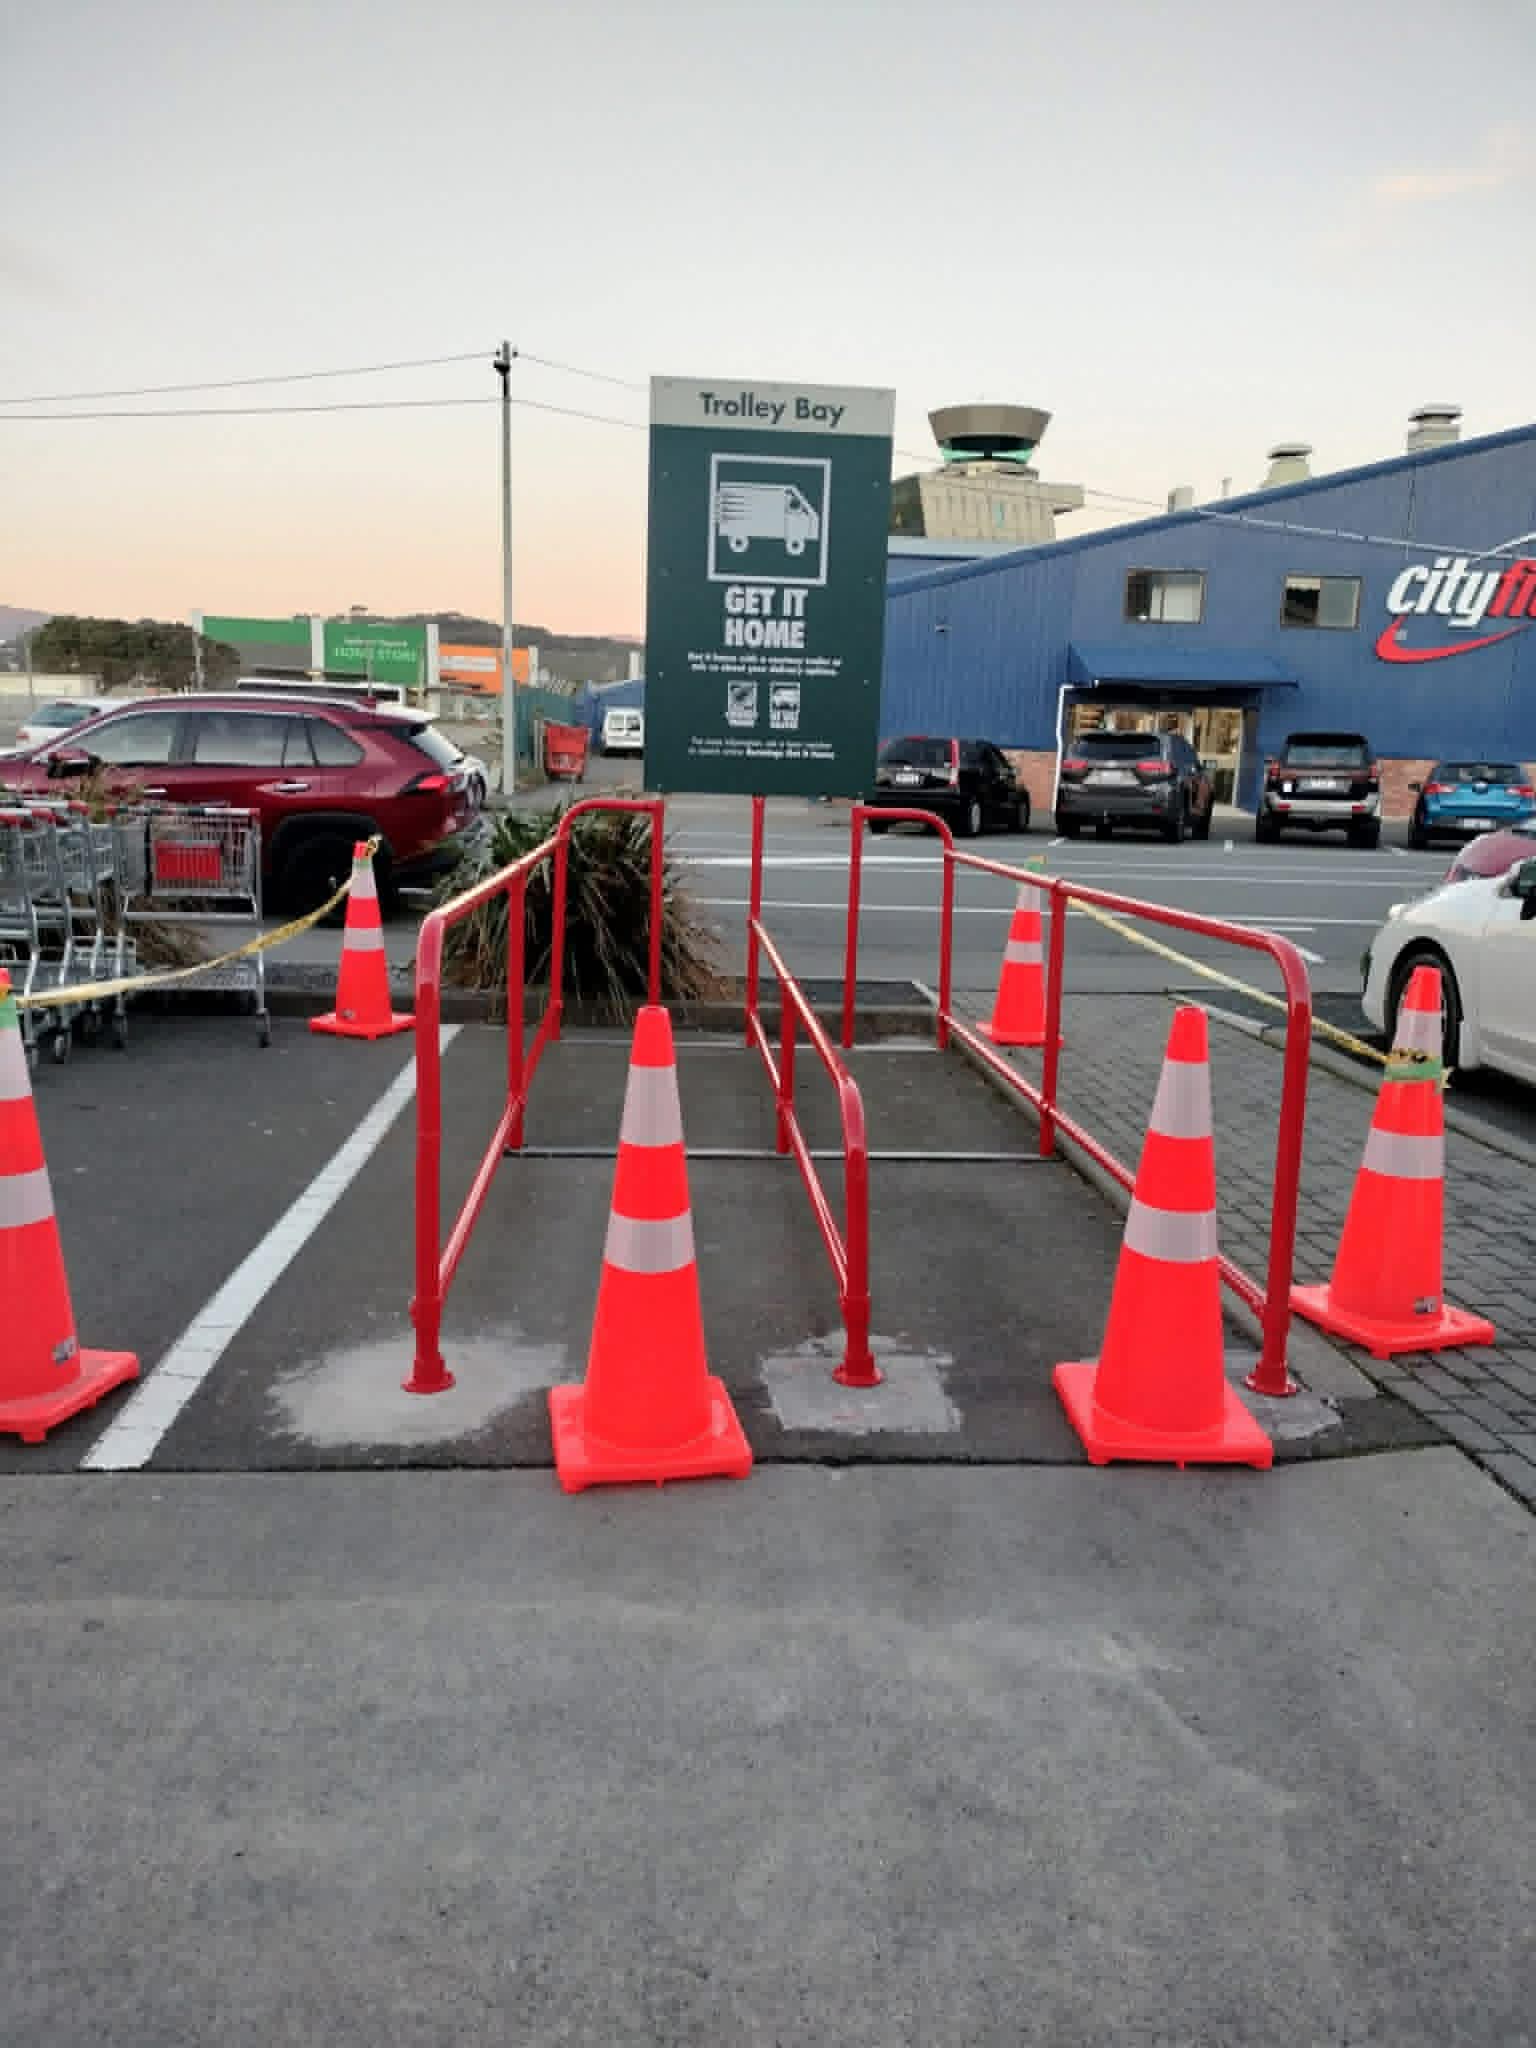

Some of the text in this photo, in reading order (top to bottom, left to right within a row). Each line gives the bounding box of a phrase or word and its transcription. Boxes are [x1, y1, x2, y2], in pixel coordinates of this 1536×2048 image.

[699, 391, 845, 428] Trolley Bay
[724, 585, 809, 617] GET IT
[724, 617, 806, 649] HOME
